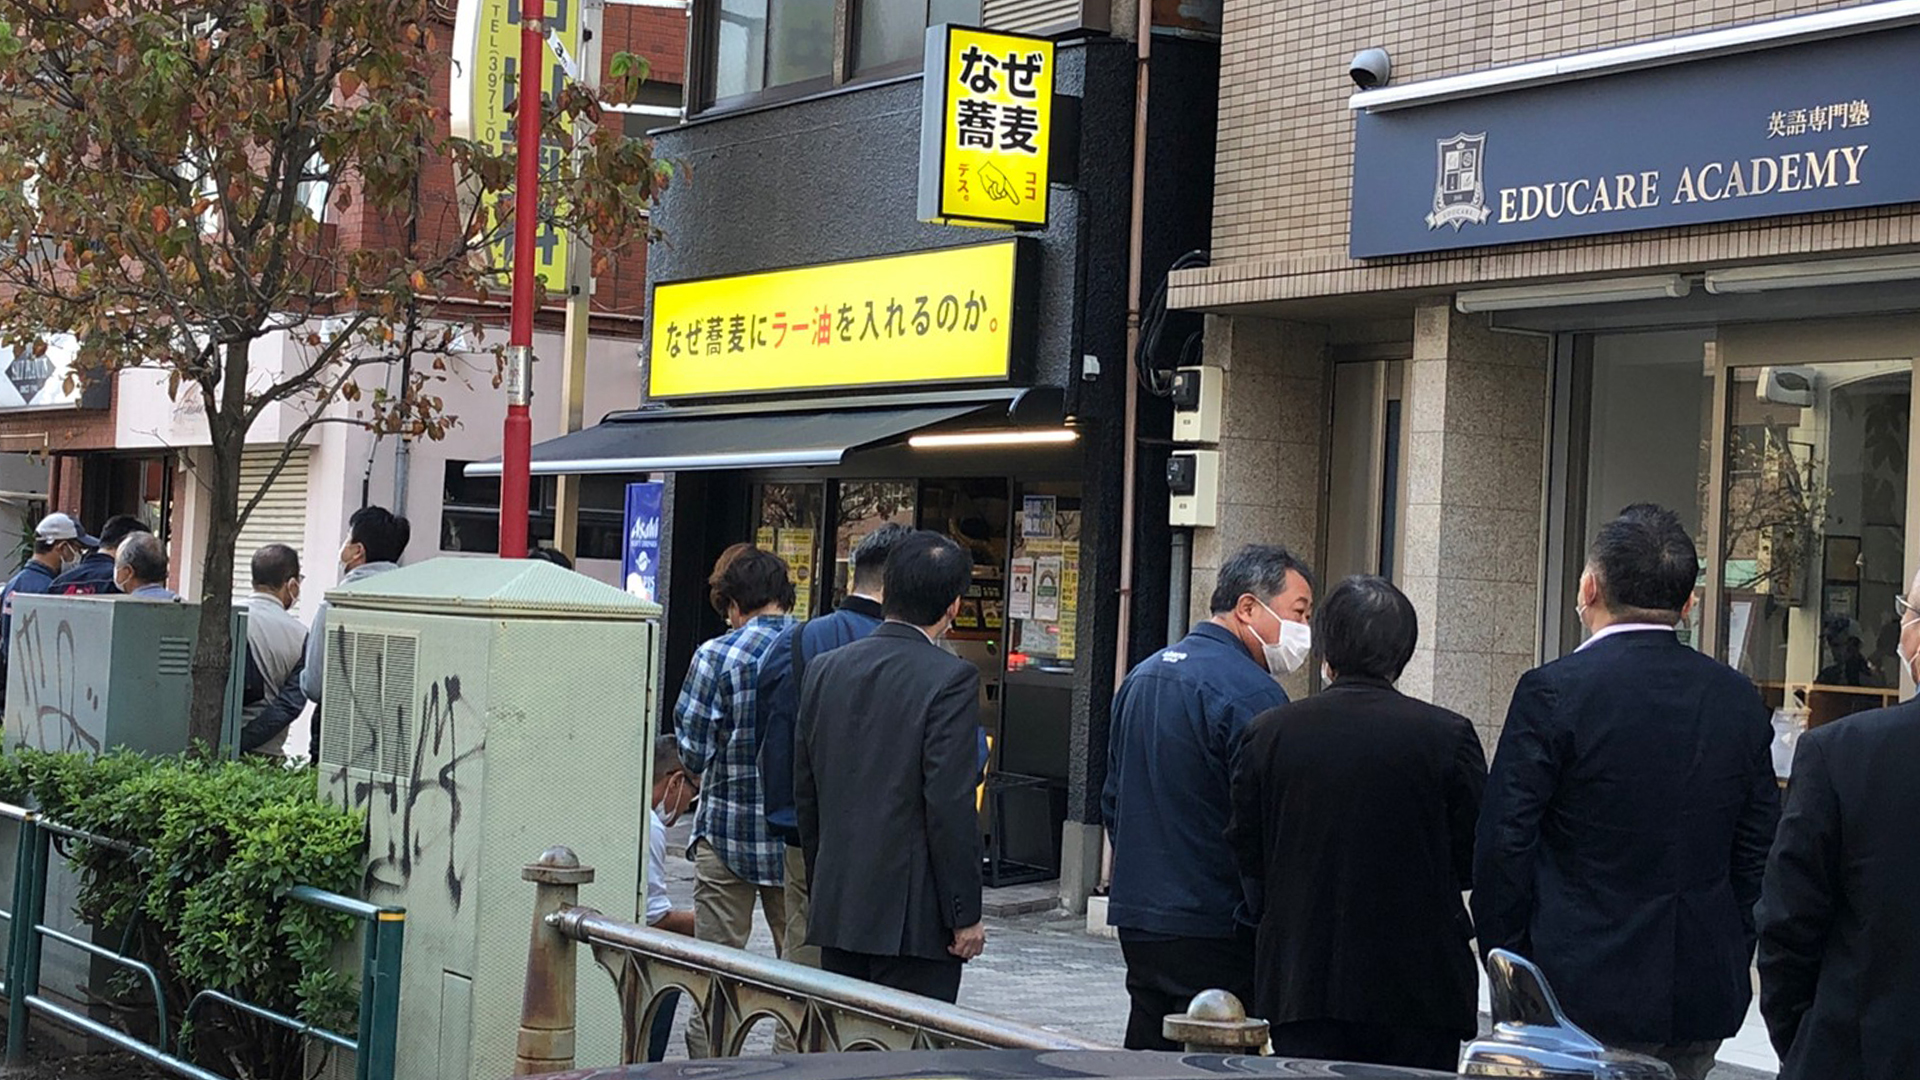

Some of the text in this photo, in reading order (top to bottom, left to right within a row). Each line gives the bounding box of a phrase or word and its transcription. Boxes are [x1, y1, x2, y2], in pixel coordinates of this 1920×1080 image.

[960, 46, 1043, 99] なぜ
[958, 99, 1038, 154] 蕎麦
[1766, 99, 1870, 139] 英語専門塾
[1025, 171, 1037, 201] ココ
[1497, 144, 1869, 224] EDUCARE ACADEMY
[666, 290, 998, 358] なぜ蕎麦にラー油を入れるのか。
